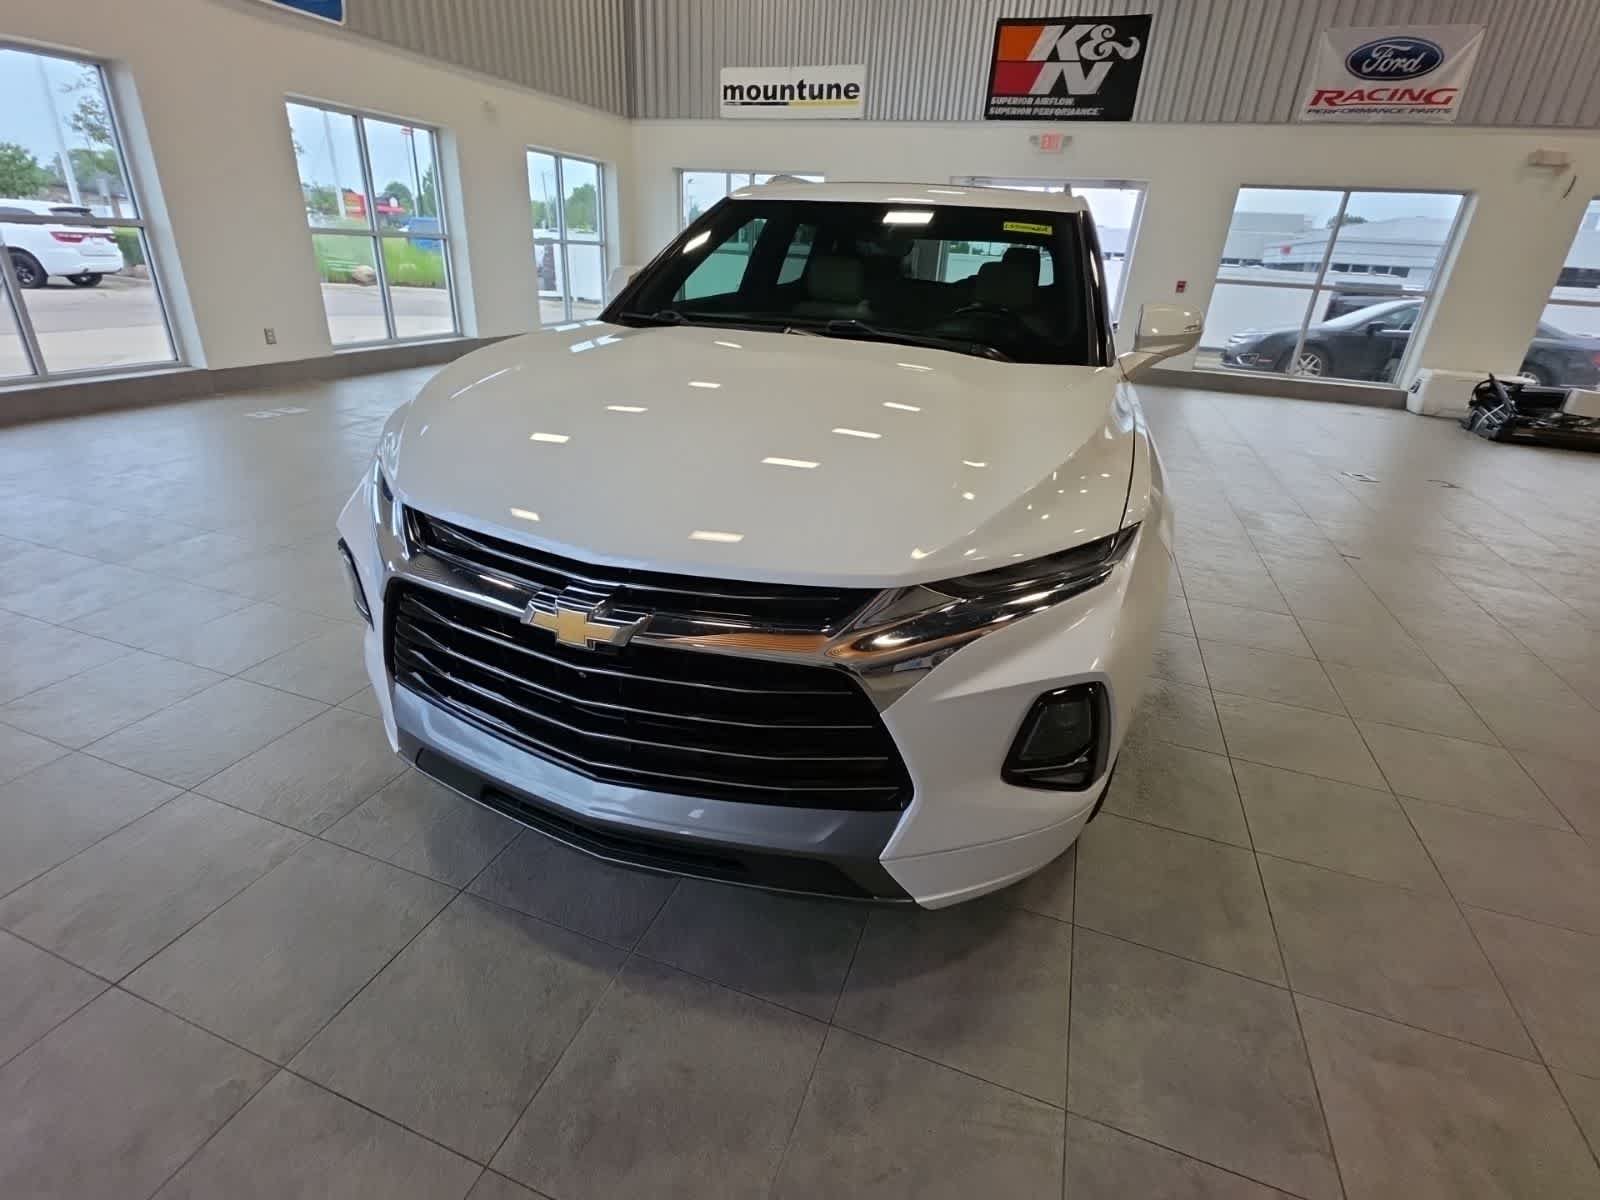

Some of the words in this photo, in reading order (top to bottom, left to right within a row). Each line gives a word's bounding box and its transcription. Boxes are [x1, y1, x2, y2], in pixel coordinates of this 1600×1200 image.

[1362, 45, 1426, 73] Ford
[723, 79, 860, 101] mountune
[1310, 88, 1458, 106] RACING
[991, 96, 1033, 105] SUPERIOR
[989, 106, 1032, 115] SUPERIOR
